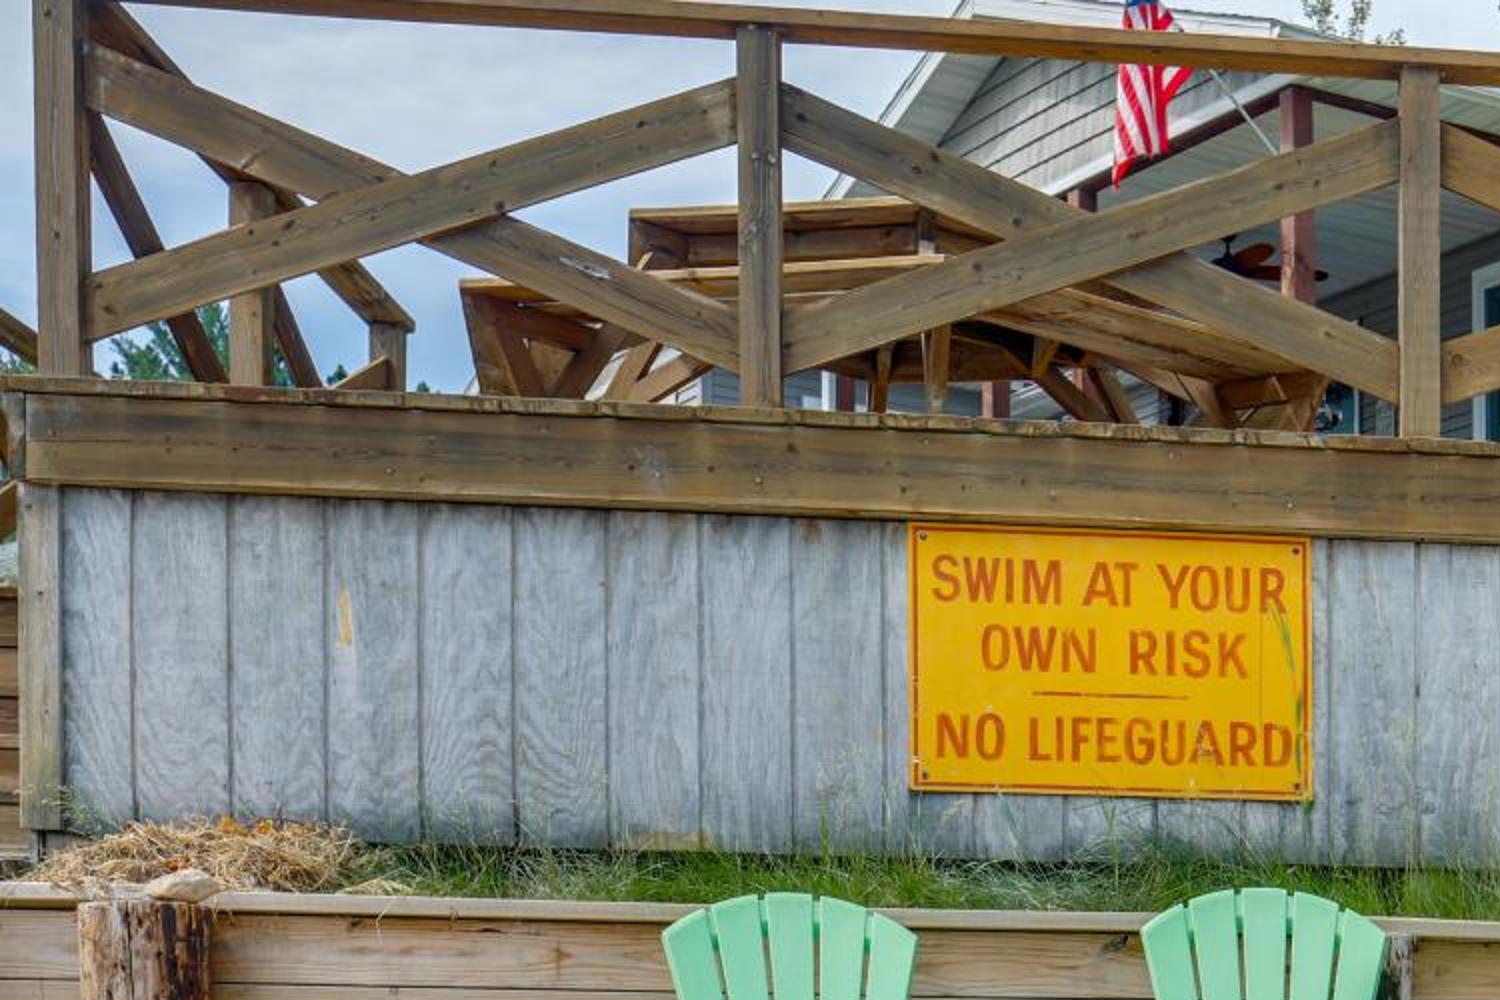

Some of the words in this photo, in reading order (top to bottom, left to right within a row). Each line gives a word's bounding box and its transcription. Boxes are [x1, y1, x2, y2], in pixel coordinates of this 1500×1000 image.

[931, 553, 1062, 606] SWIM
[1081, 560, 1139, 608] AT
[1157, 563, 1288, 614] YOUR
[981, 624, 1097, 673] OWN
[1128, 629, 1249, 679] RISK
[935, 712, 1006, 761] NO
[1028, 716, 1294, 768] LIFEGUARD
